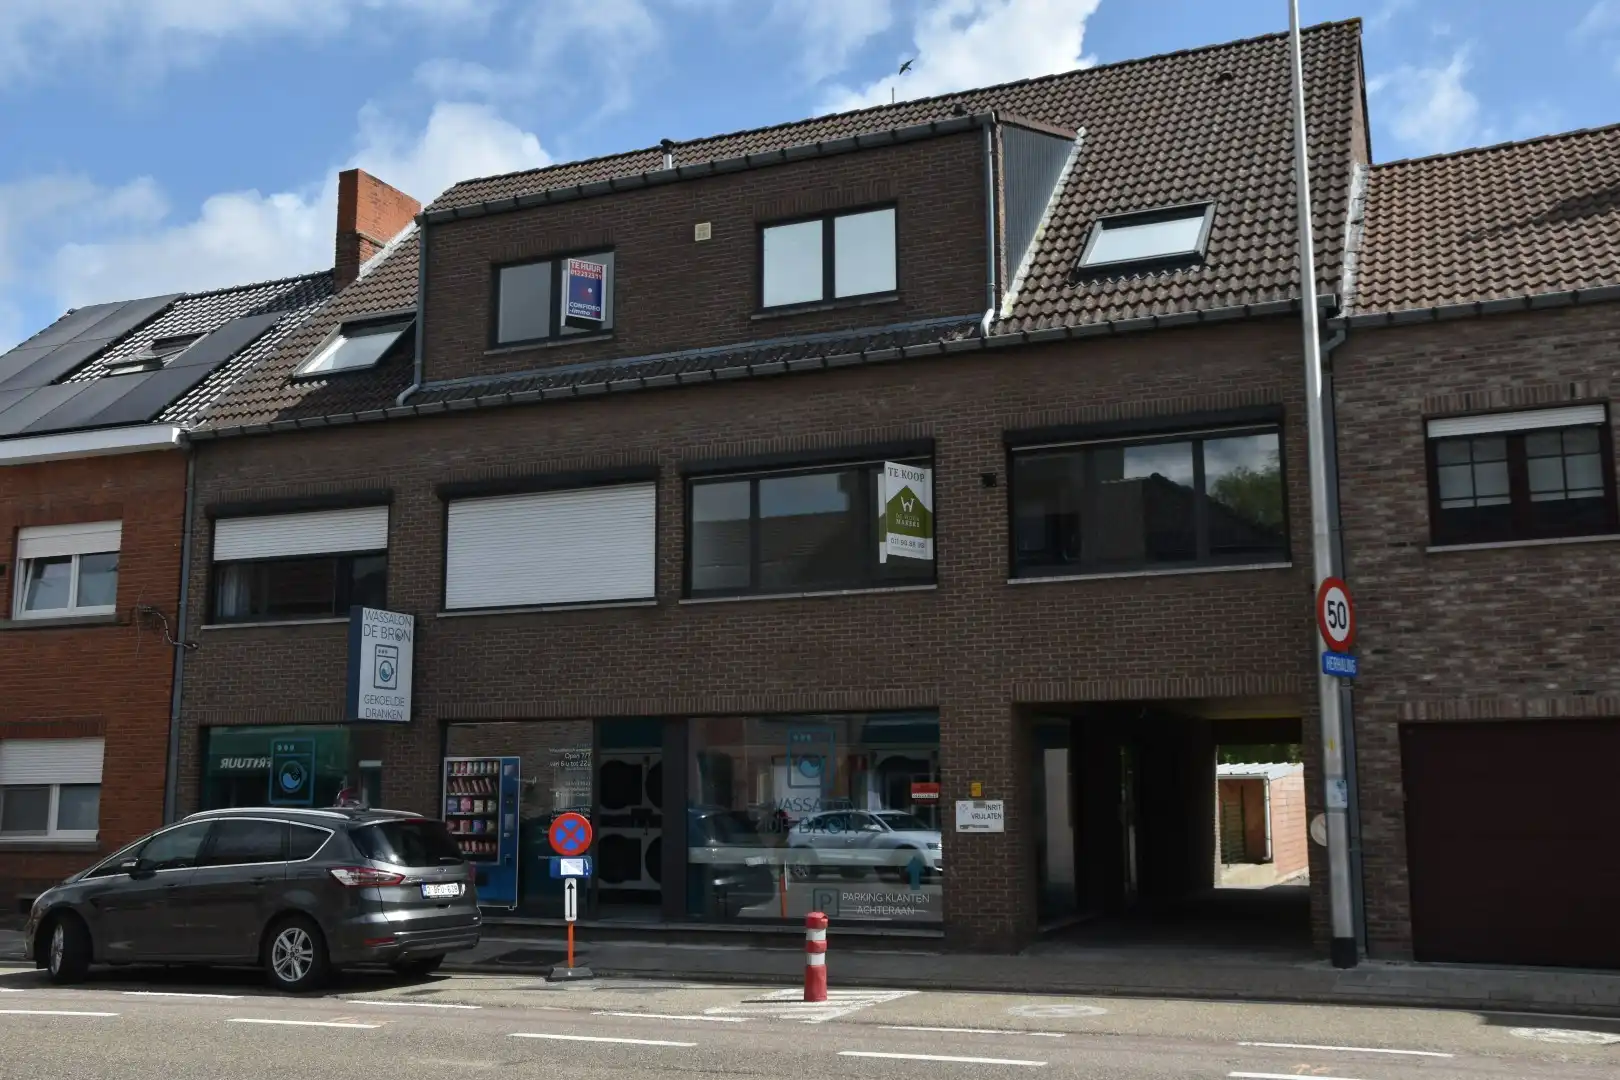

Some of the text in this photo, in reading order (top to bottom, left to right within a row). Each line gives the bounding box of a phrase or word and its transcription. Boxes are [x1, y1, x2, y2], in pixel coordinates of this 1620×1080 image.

[570, 260, 602, 273] TE HUUR
[888, 467, 925, 482] TE KOOP
[364, 609, 412, 627] WASSALON
[1328, 600, 1346, 630] 50
[363, 623, 411, 643] DE BRON
[363, 694, 405, 707] GEKOELDE
[365, 707, 403, 720] DRANKEN
[985, 803, 1002, 811] INRIT
[970, 812, 1002, 820] VRIJLATEN
[842, 892, 930, 903] PARKING KLANTEN
[857, 905, 915, 916] ACHTERAAN
